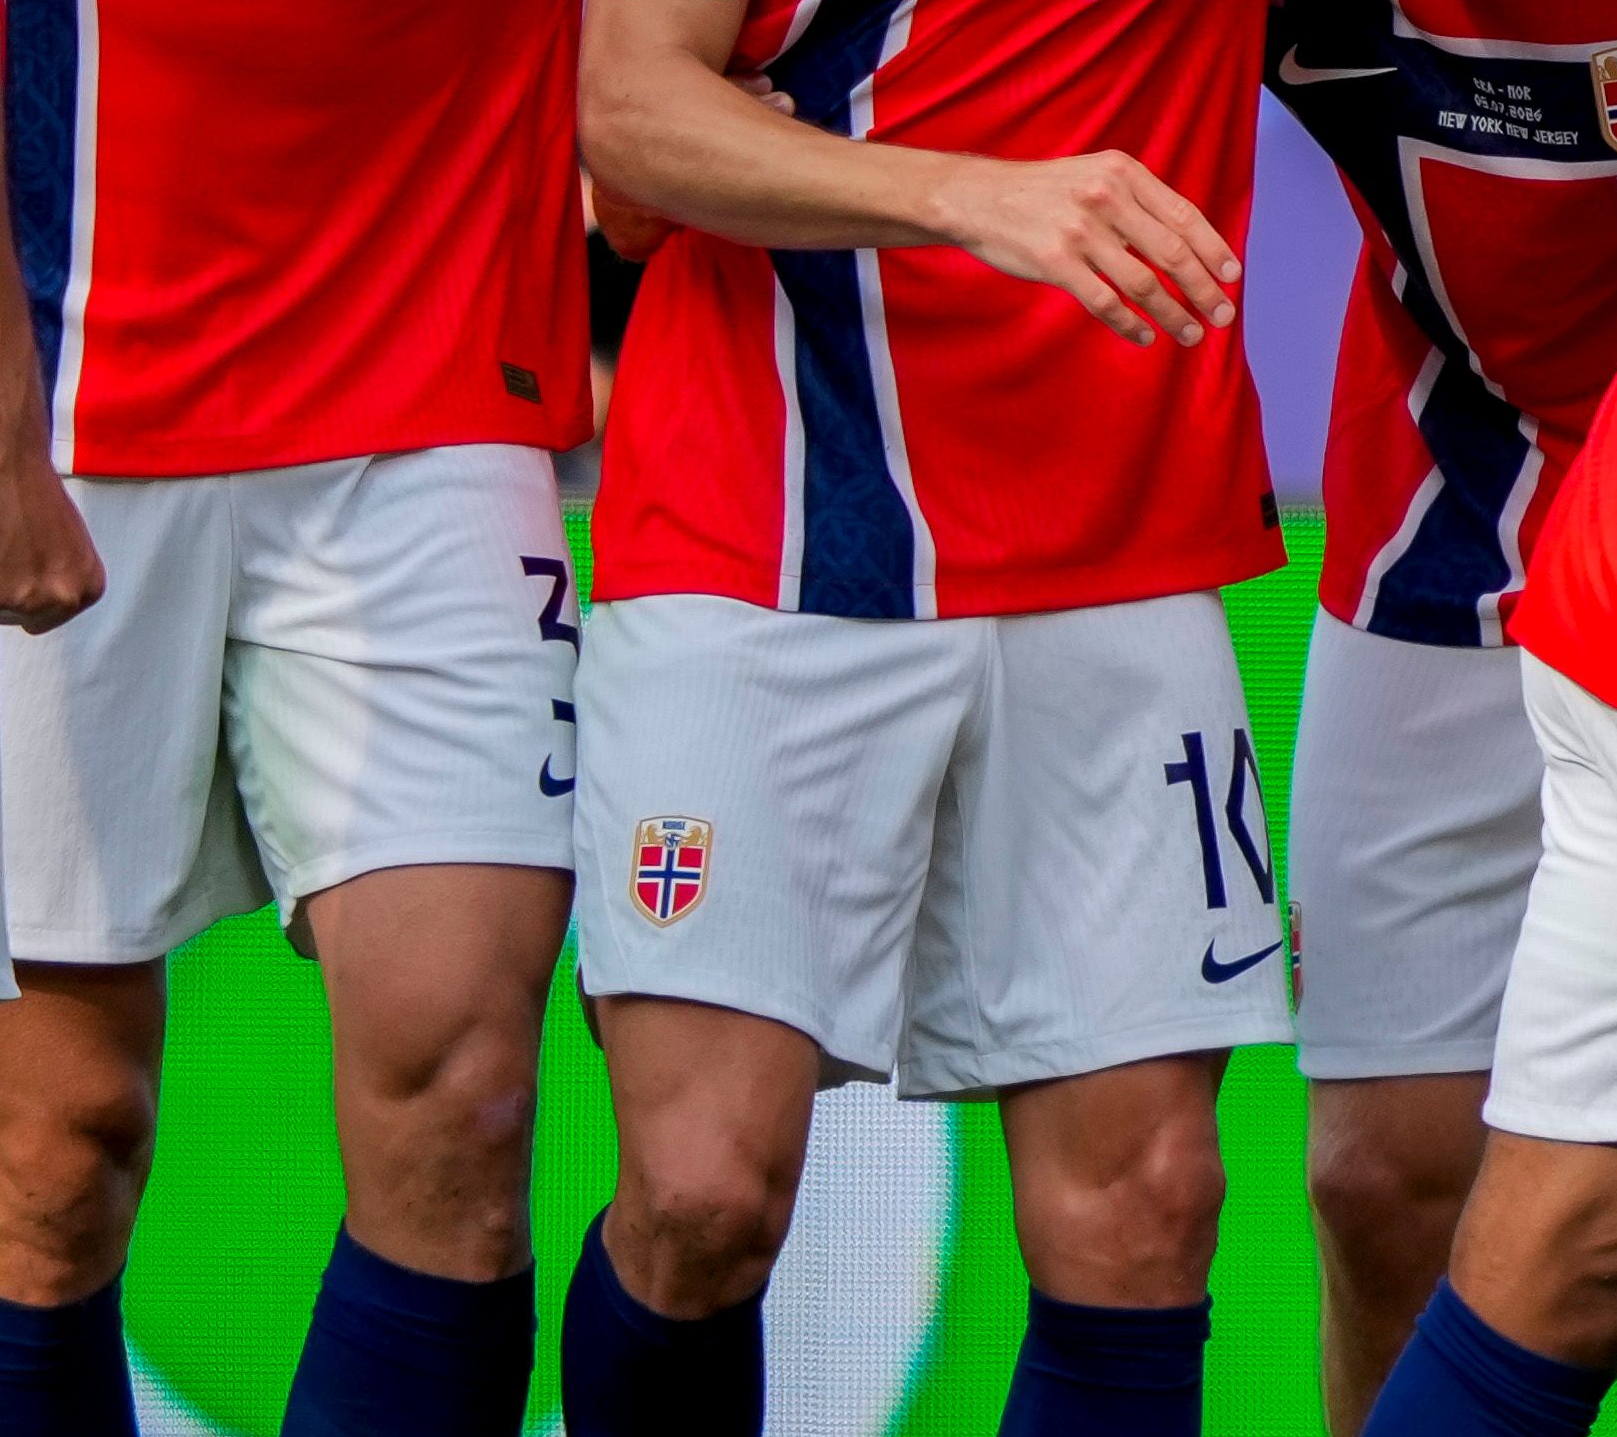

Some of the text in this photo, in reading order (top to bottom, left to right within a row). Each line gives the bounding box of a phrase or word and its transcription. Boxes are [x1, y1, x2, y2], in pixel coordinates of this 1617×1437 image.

[1507, 84, 1532, 101] NOR
[1438, 110, 1579, 146] NEW YORK NEW JERSEY
[1163, 727, 1275, 910] 10
